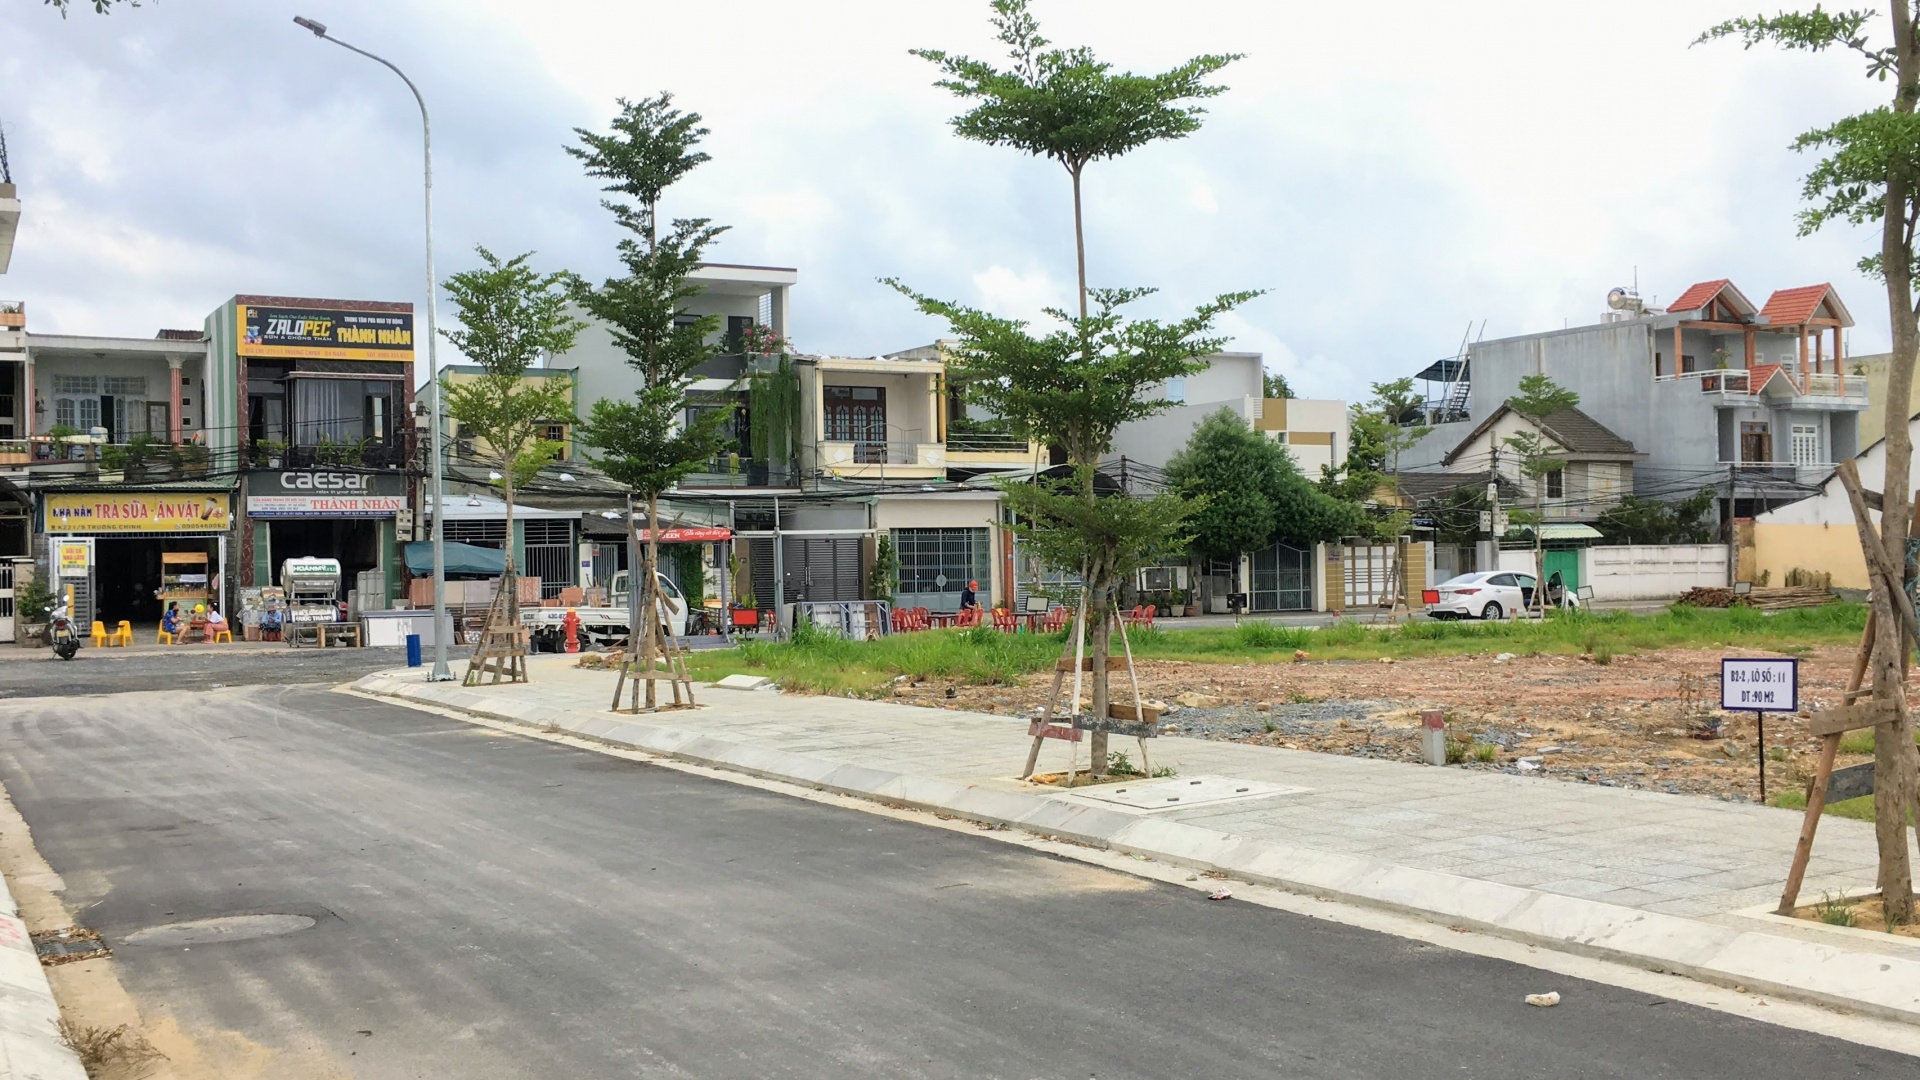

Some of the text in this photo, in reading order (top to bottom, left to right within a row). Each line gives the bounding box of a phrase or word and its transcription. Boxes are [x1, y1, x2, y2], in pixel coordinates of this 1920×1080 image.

[266, 319, 331, 336] ZALOPEC
[337, 325, 411, 345] THÀNH NHÂN
[95, 500, 120, 518] TRÀ
[123, 500, 148, 518] SỮA
[158, 501, 174, 518] ĂN
[310, 497, 400, 509] THÀNH NHÂN
[1751, 668, 1760, 682] LÔ
[1762, 667, 1772, 682] SỐ
[1764, 691, 1774, 703] M2
